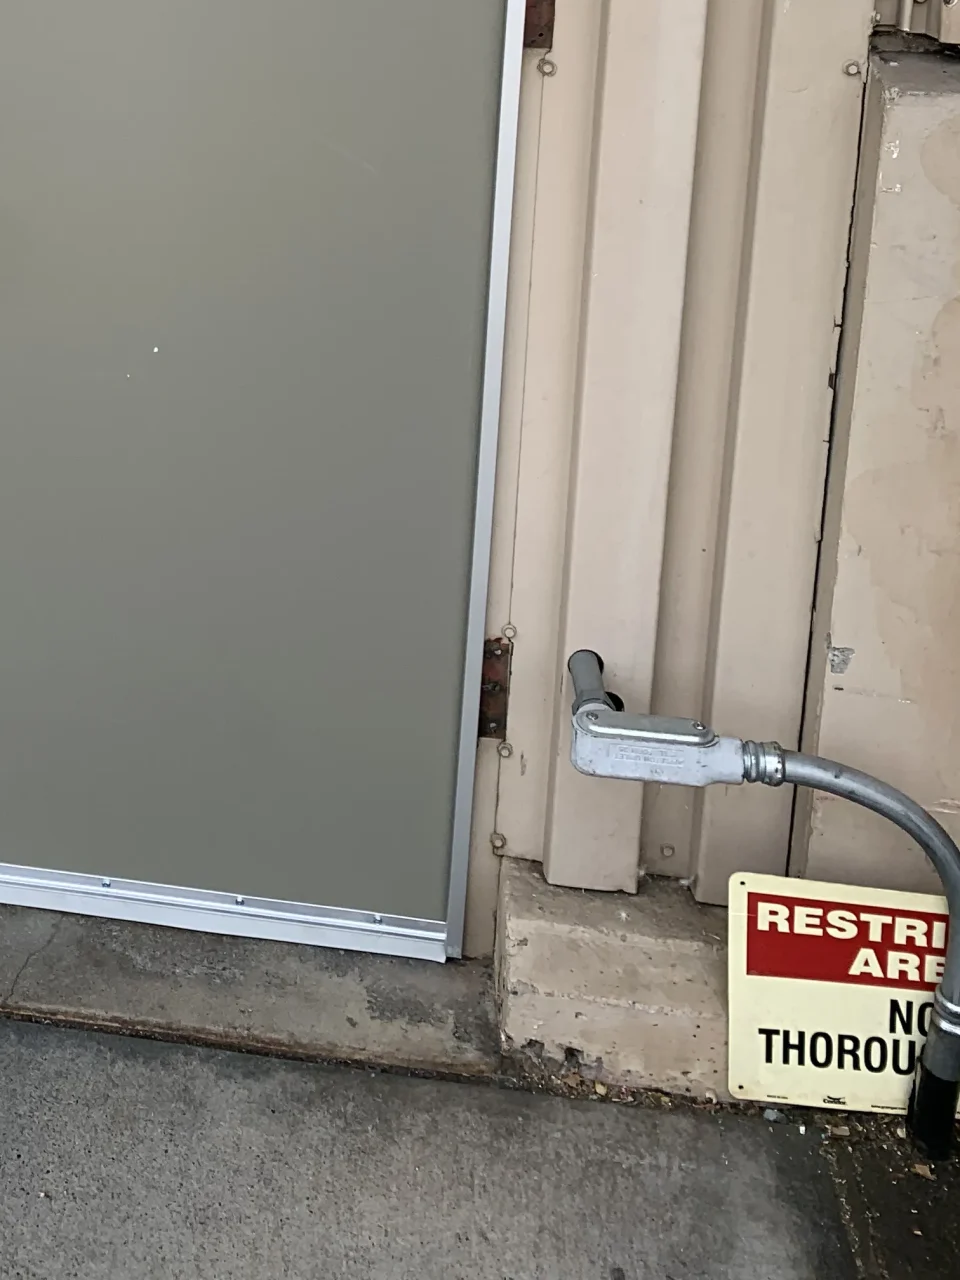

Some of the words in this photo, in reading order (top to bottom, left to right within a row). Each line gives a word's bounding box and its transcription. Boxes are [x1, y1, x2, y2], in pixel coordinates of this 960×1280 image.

[757, 901, 946, 949] RESTRI
[848, 947, 945, 984] ARE
[758, 1028, 925, 1076] THOROU
